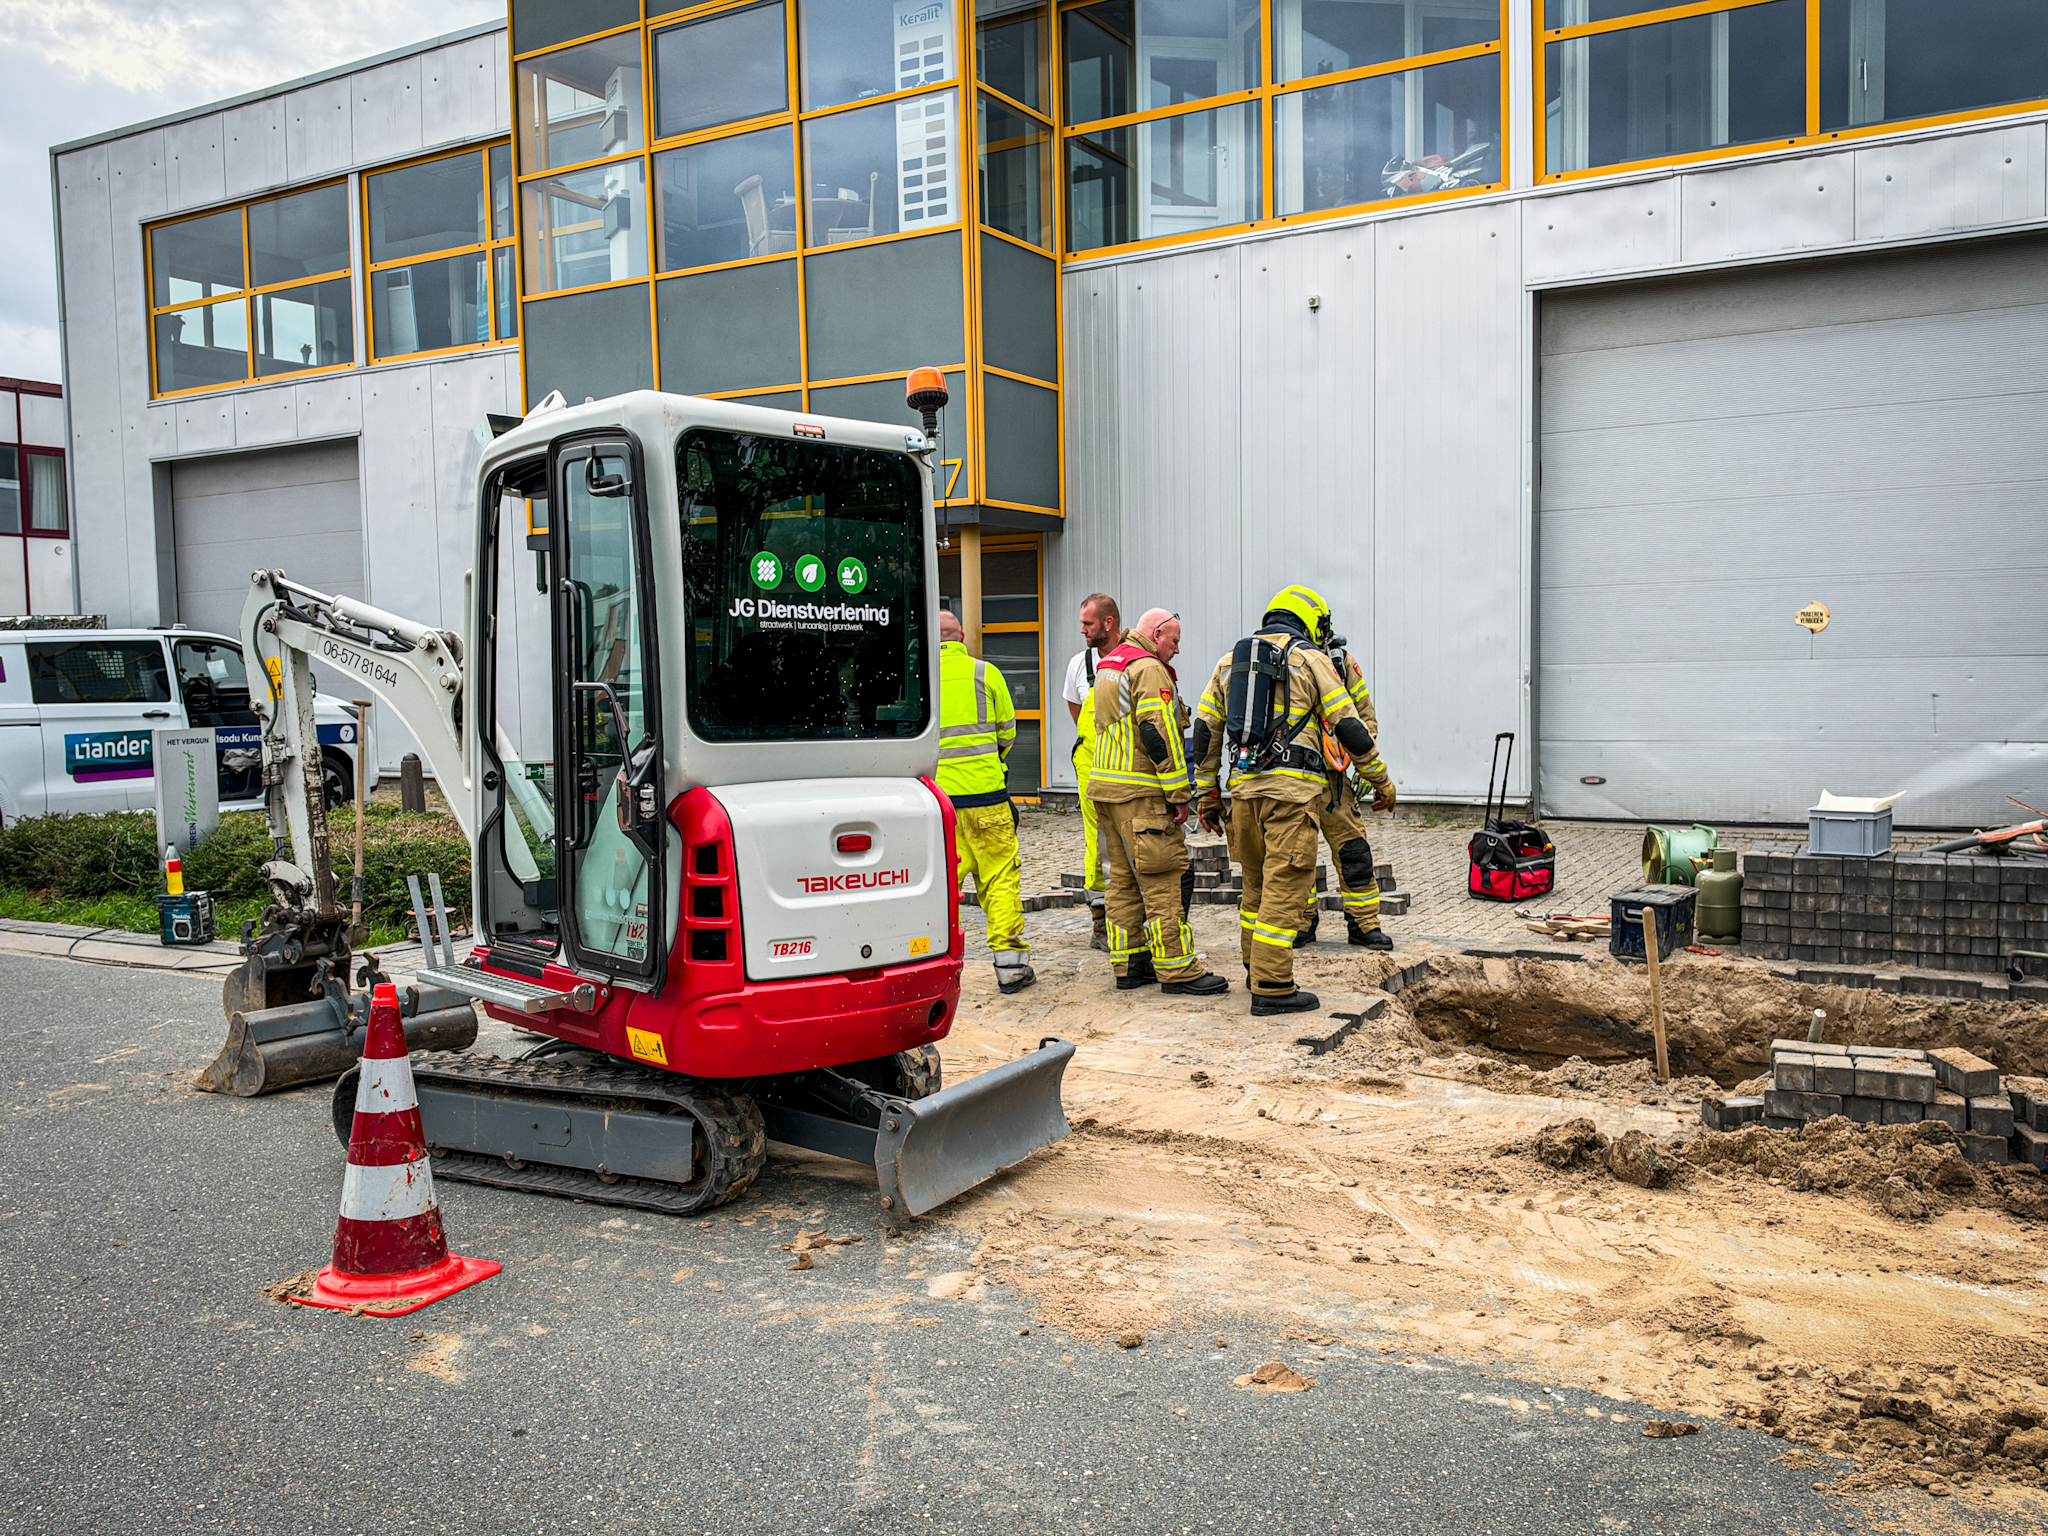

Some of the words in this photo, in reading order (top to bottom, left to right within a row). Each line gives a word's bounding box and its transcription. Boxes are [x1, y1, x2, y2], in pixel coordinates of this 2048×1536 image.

[900, 7, 940, 26] Keralit
[940, 458, 962, 498] 7
[728, 598, 755, 617] JG
[757, 598, 890, 626] Dienstverlening
[759, 620, 793, 629] straatwerk
[797, 621, 829, 631] tuinaanleg
[831, 622, 863, 632] grondwerk
[324, 640, 361, 669] 06-577
[166, 738, 180, 746] HET
[181, 737, 210, 745] VERGUN
[242, 733, 263, 742] Kuns
[343, 729, 350, 737] 7
[75, 735, 150, 760] Liander
[184, 750, 197, 822] Westervoort
[796, 868, 909, 893] TAKEUCHI
[773, 941, 812, 956] TB216
